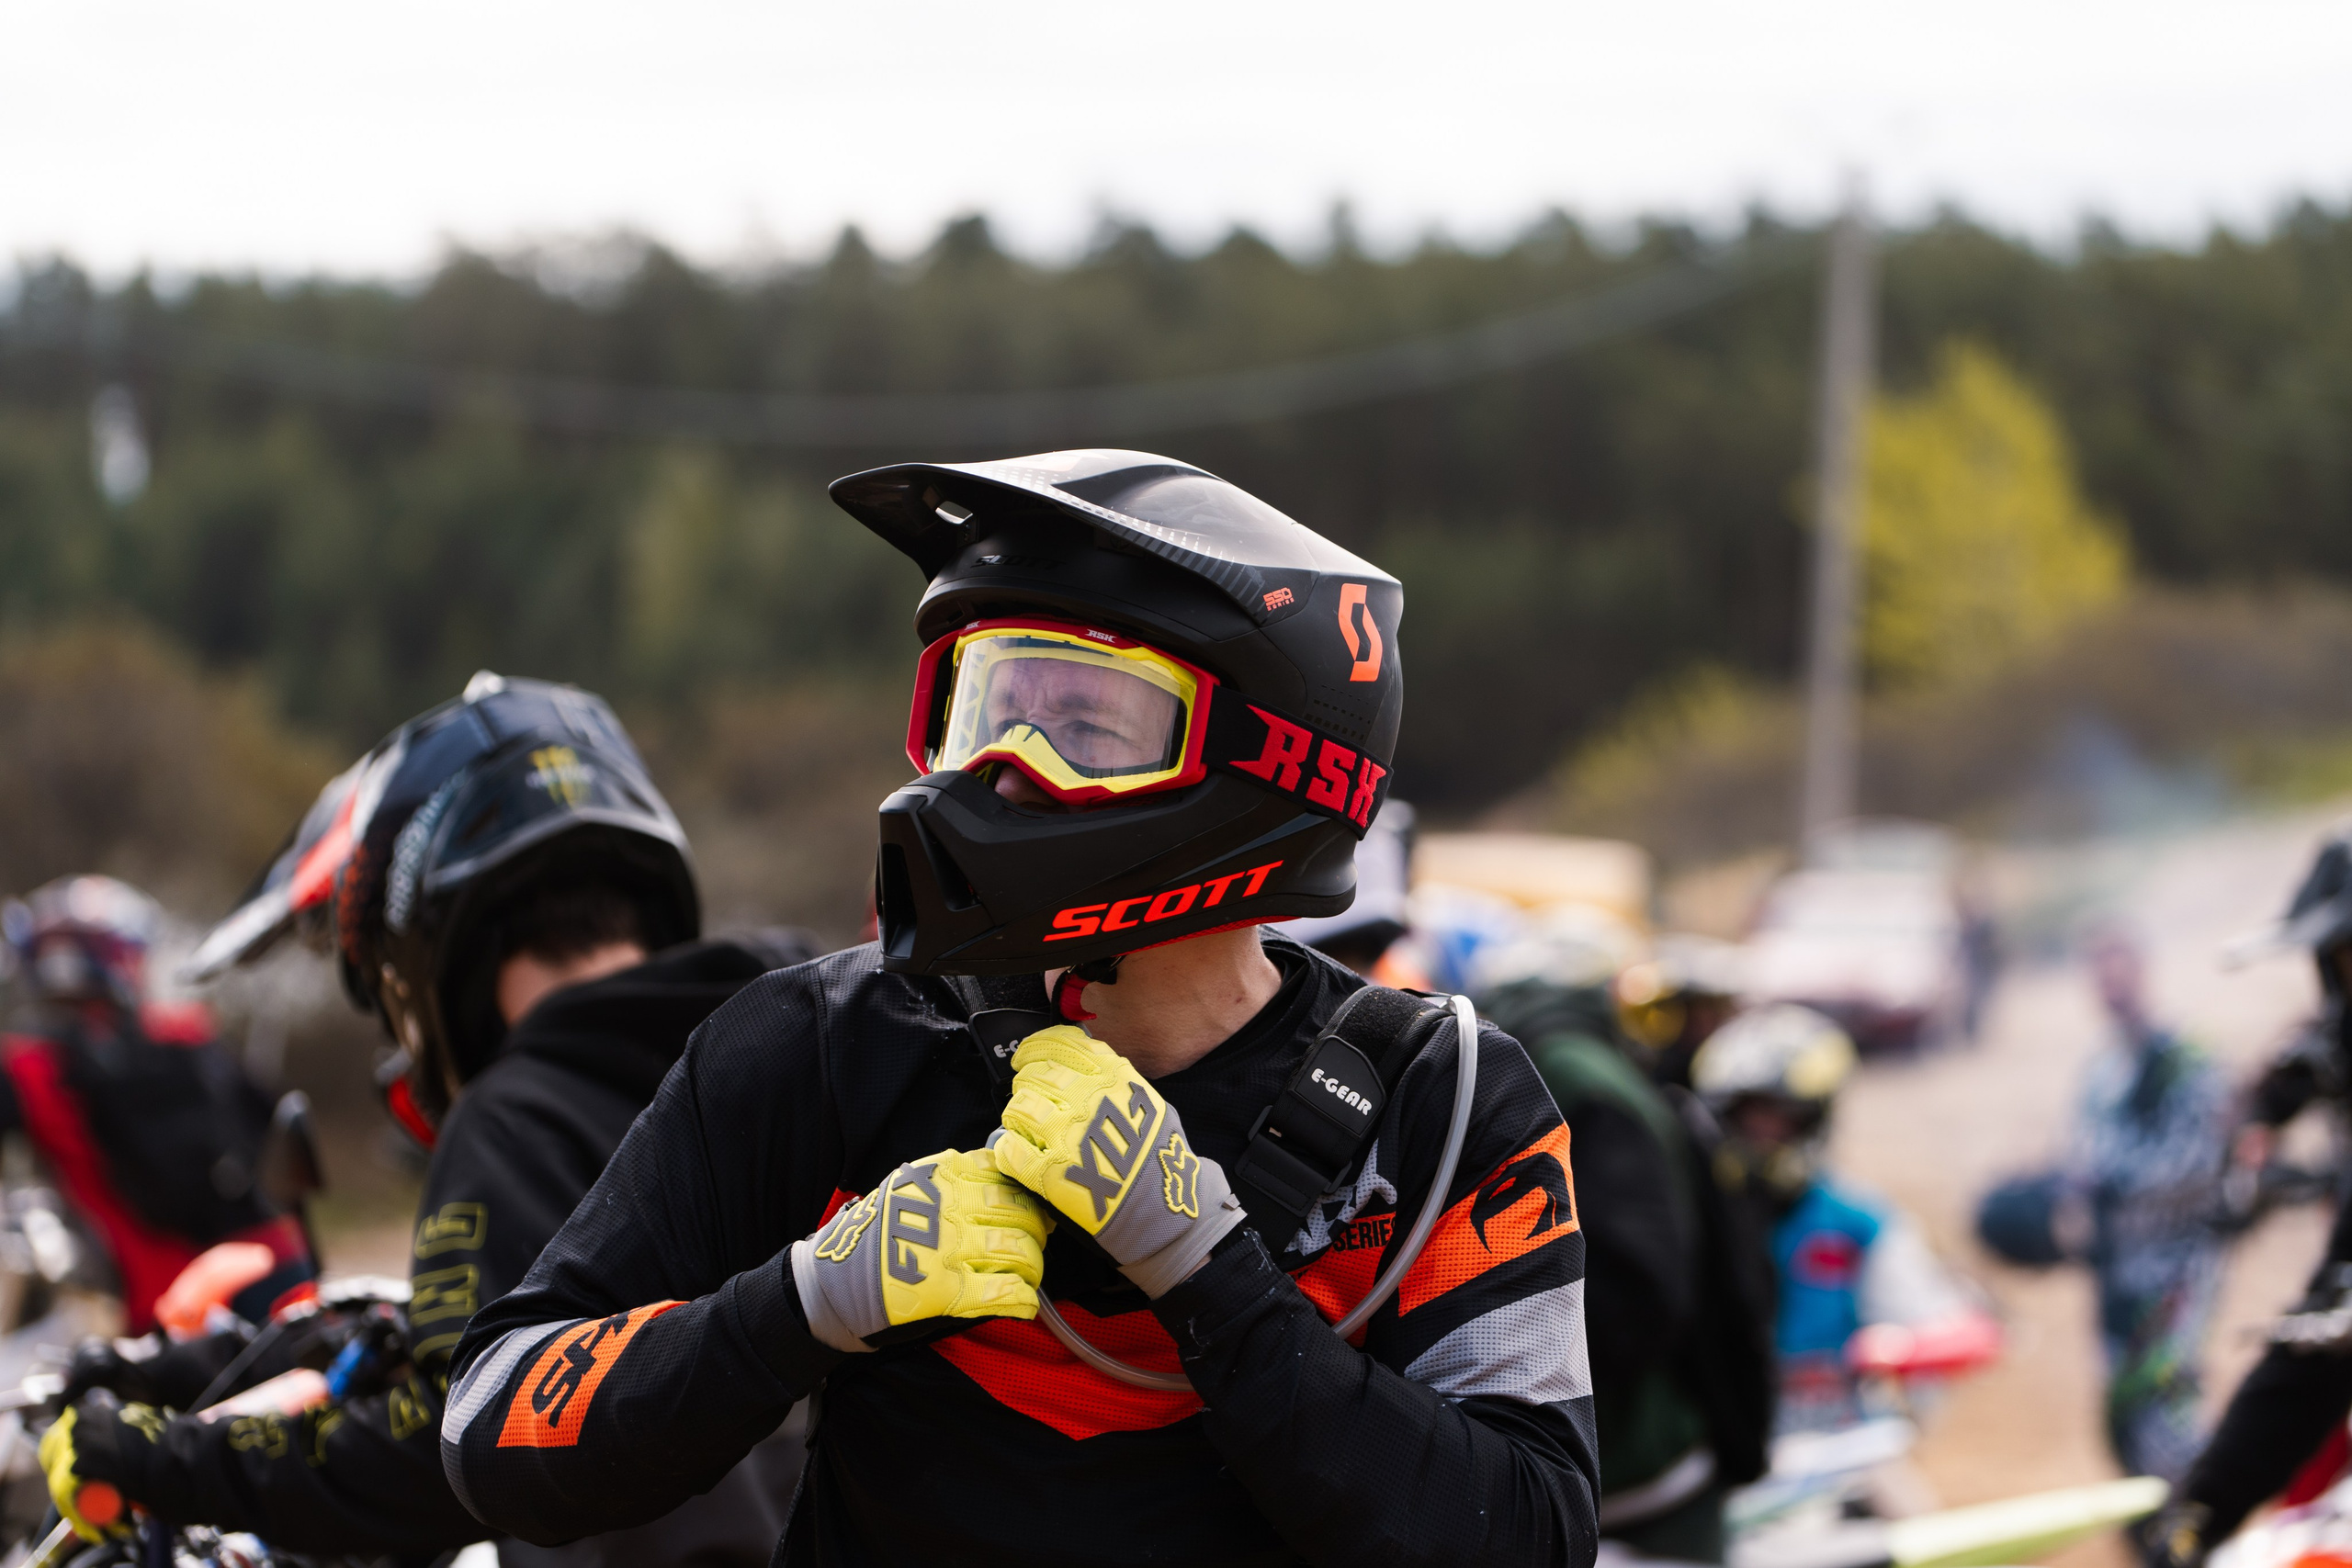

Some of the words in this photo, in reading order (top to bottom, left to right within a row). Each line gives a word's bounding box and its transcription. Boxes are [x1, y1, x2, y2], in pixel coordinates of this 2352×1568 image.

[1043, 860, 1284, 942] SCOTT
[1311, 1067, 1373, 1116] E-GEAR
[1065, 1081, 1158, 1222] FOX
[888, 1162, 942, 1285] FOX
